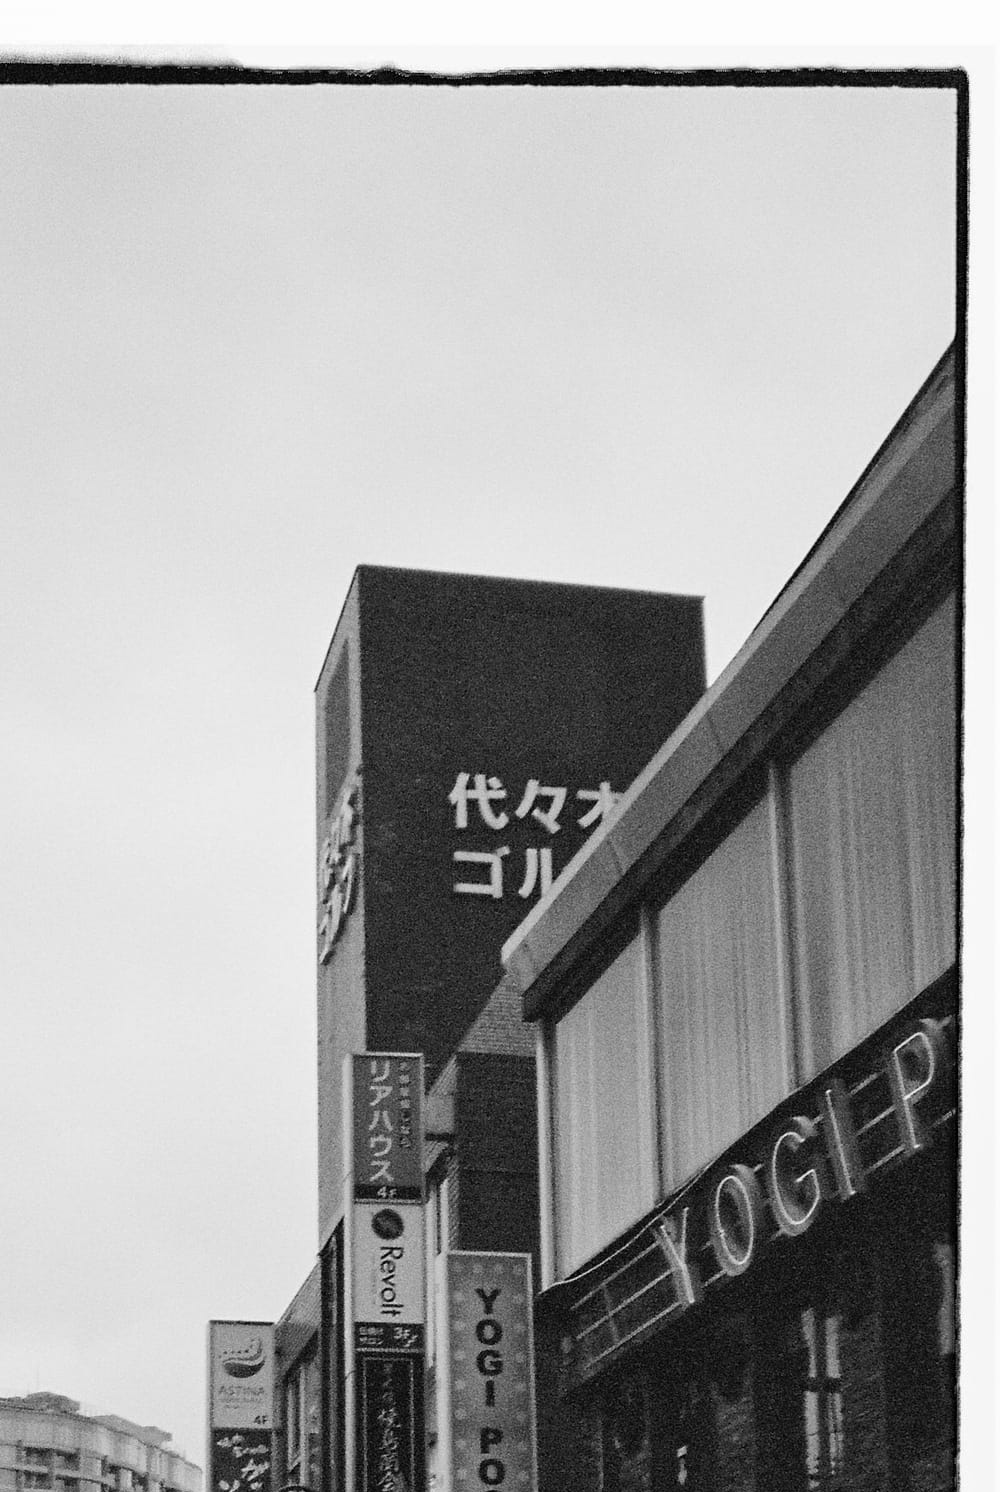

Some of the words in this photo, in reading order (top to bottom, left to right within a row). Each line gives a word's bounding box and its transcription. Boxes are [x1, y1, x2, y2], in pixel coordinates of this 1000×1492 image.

[368, 1059, 395, 1183] リアハウス
[376, 1186, 397, 1199] 4F
[653, 1085, 856, 1306] YOGI
[381, 1246, 404, 1317] Revolt
[475, 1287, 504, 1408] YOGI
